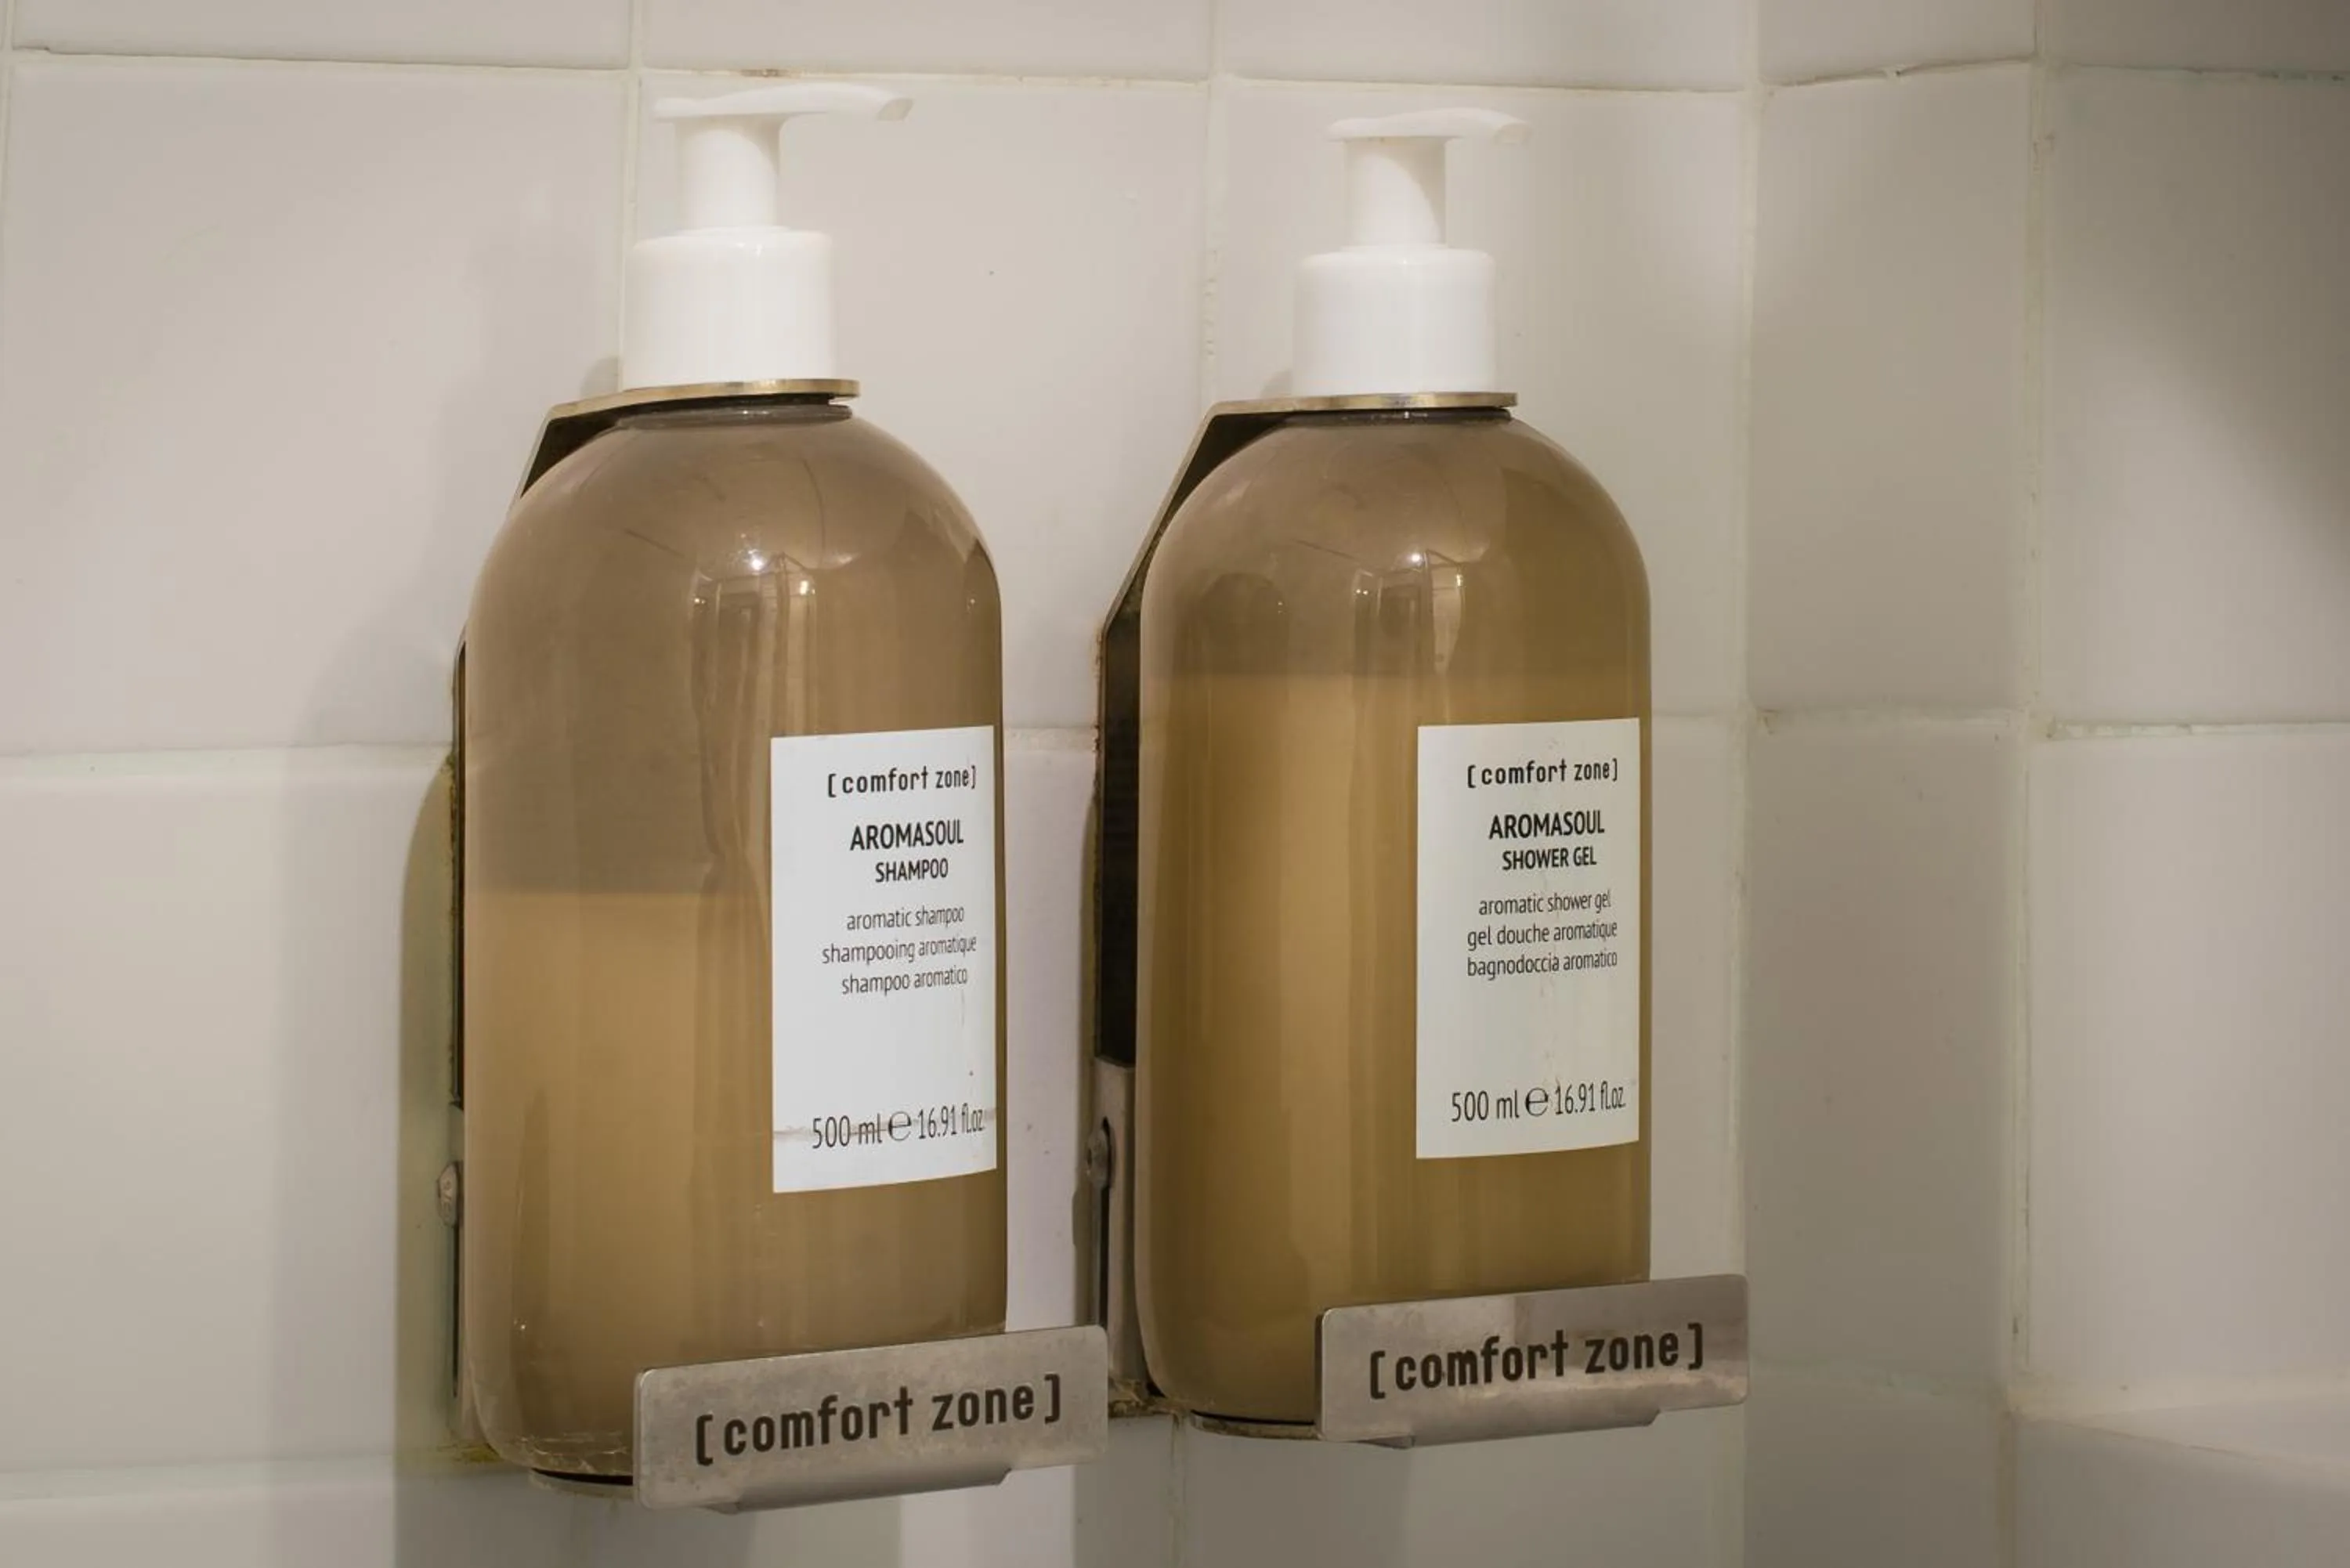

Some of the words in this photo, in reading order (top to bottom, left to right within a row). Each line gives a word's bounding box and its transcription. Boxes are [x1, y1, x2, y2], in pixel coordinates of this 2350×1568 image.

[849, 819, 964, 851] AROMASOUL
[1488, 810, 1605, 840] AROMASOUL
[875, 858, 949, 883] SHAMPOO
[1502, 847, 1569, 871] SHOWER
[1573, 846, 1597, 866] GEL
[846, 907, 911, 930] aromatic
[914, 905, 964, 928] shampoo
[1478, 893, 1543, 916] aromatic
[1547, 892, 1593, 913] shower
[1594, 889, 1611, 914] gel
[822, 940, 915, 966] shampooing
[918, 936, 977, 958] aromatique
[1467, 927, 1492, 952] gel
[1496, 923, 1550, 945] douche
[1553, 920, 1618, 945] aromatique
[841, 974, 910, 996] shampoo
[913, 964, 968, 989] aromatico
[1467, 956, 1560, 981] bagnodoccia
[1563, 948, 1618, 971] aromatico
[1451, 1089, 1488, 1122] 500
[1495, 1089, 1520, 1120] ml
[1555, 1081, 1596, 1116] 16.91
[812, 1115, 851, 1149] 500
[858, 1112, 882, 1144] ml
[917, 1104, 957, 1140] 16.91
